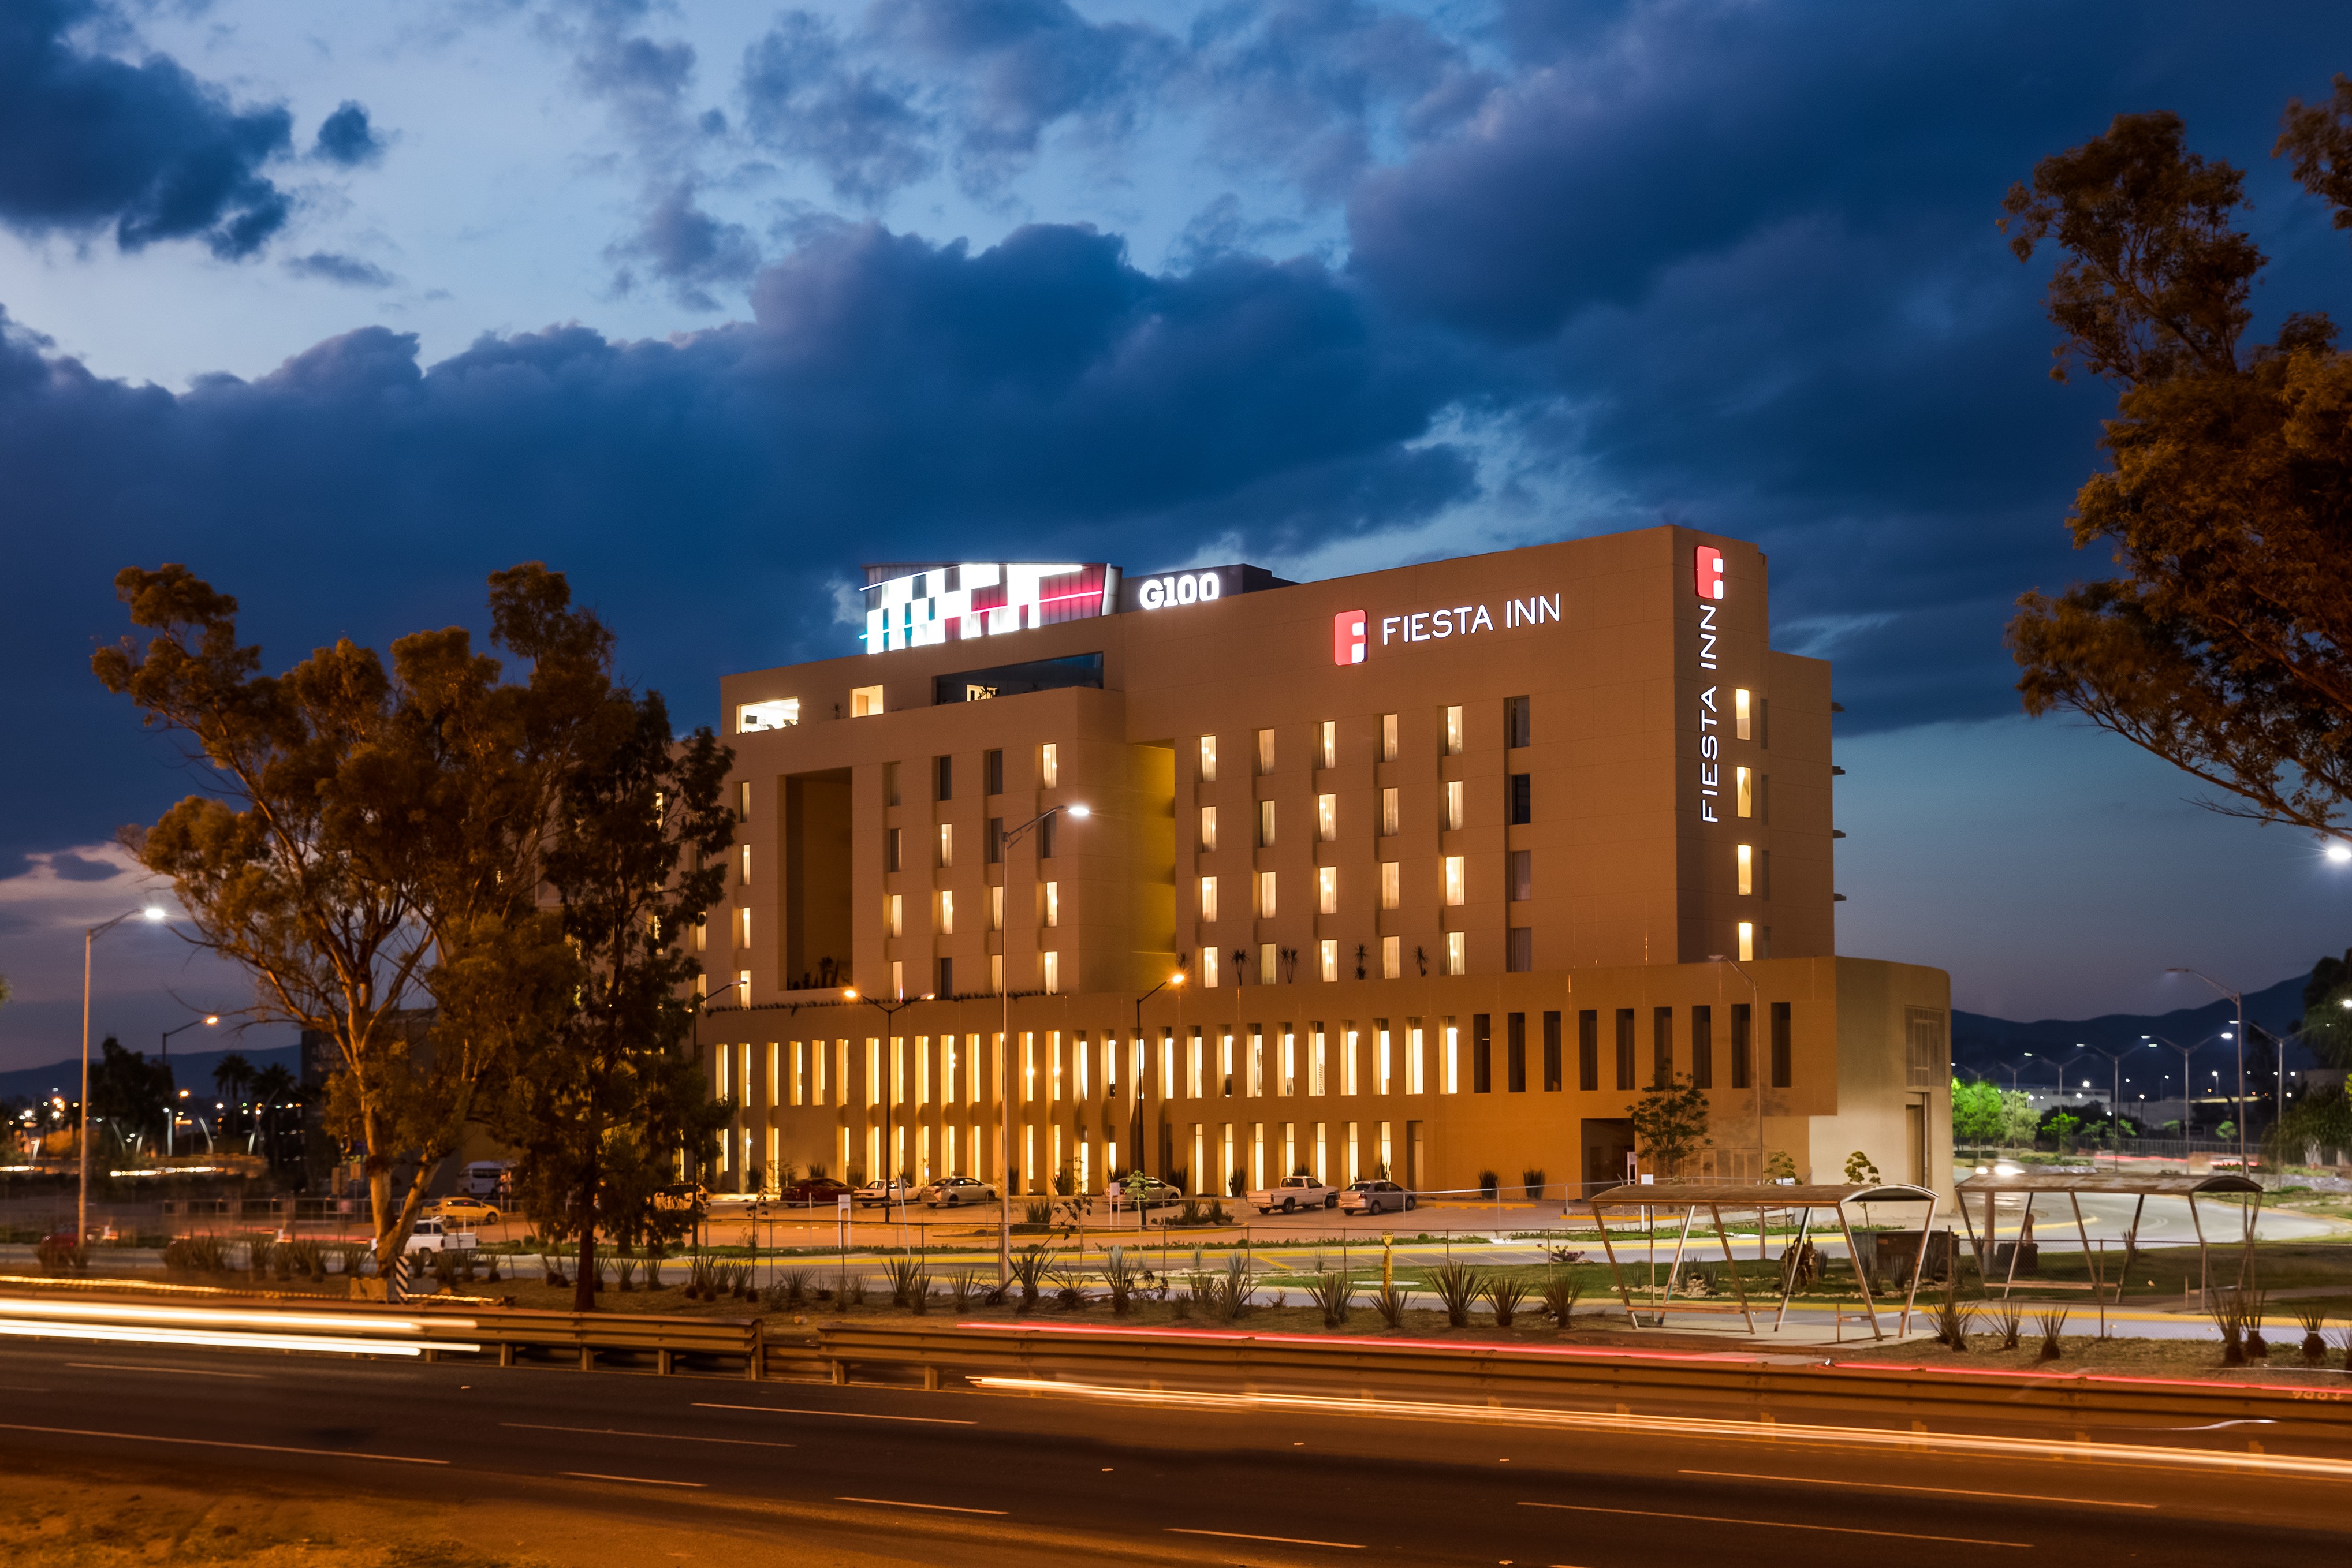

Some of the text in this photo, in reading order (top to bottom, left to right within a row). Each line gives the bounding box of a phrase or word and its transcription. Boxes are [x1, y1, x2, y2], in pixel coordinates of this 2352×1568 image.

[1139, 572, 1220, 610] G100
[1382, 593, 1560, 645] FIESTA INN
[1699, 604, 1719, 823] FIESTA INN
